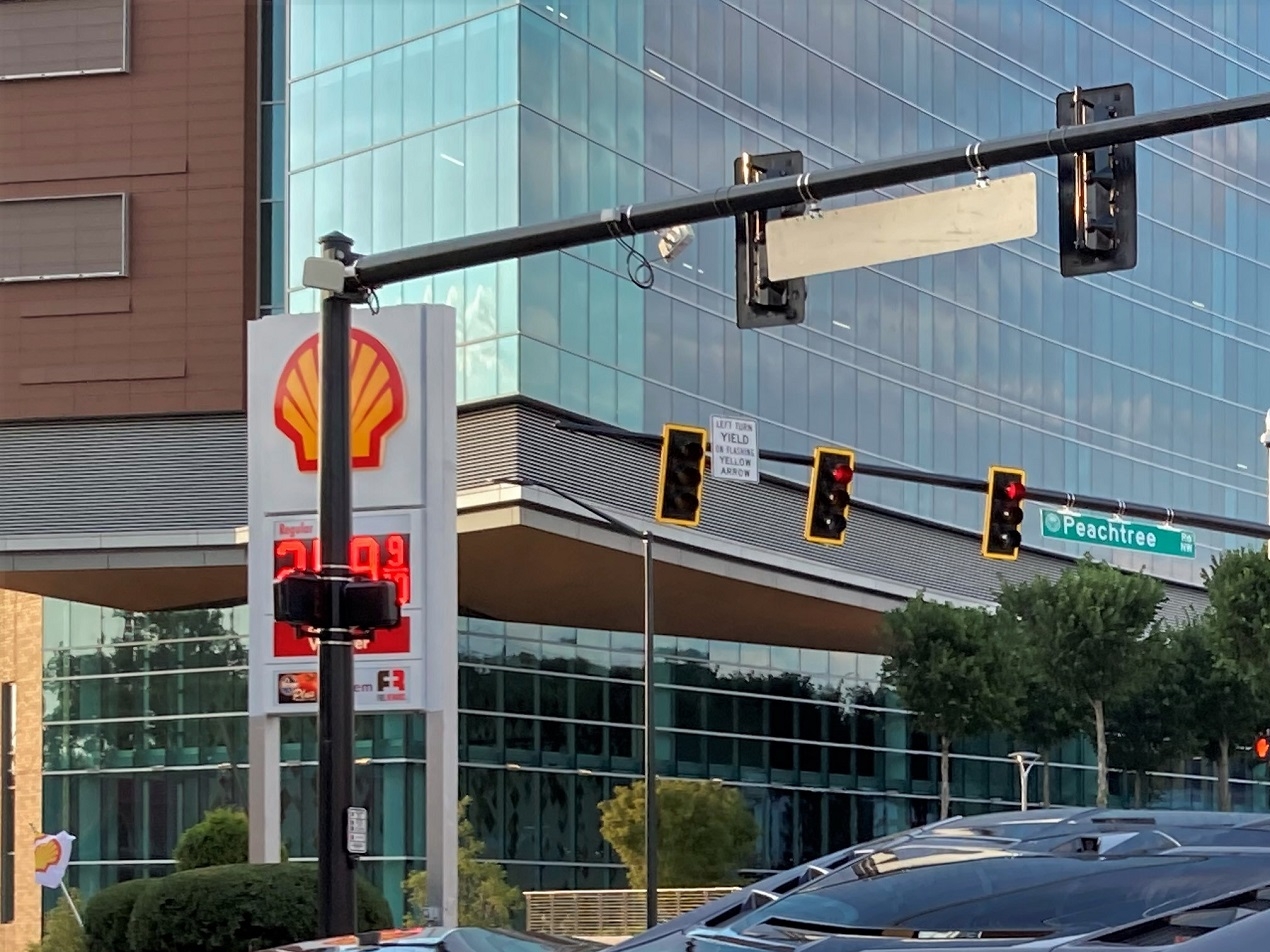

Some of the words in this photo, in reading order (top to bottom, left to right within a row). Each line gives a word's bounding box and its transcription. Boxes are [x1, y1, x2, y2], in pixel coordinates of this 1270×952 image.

[716, 420, 731, 430] LEFT
[735, 422, 753, 431] TURN
[721, 432, 749, 445] YIELD
[715, 444, 724, 453] ON
[726, 446, 755, 457] FLASHING
[719, 455, 751, 466] YELLOW
[721, 467, 750, 477] ARROW
[279, 521, 313, 537] Regular
[1063, 515, 1156, 547] Peachtree
[1180, 542, 1193, 553] NW
